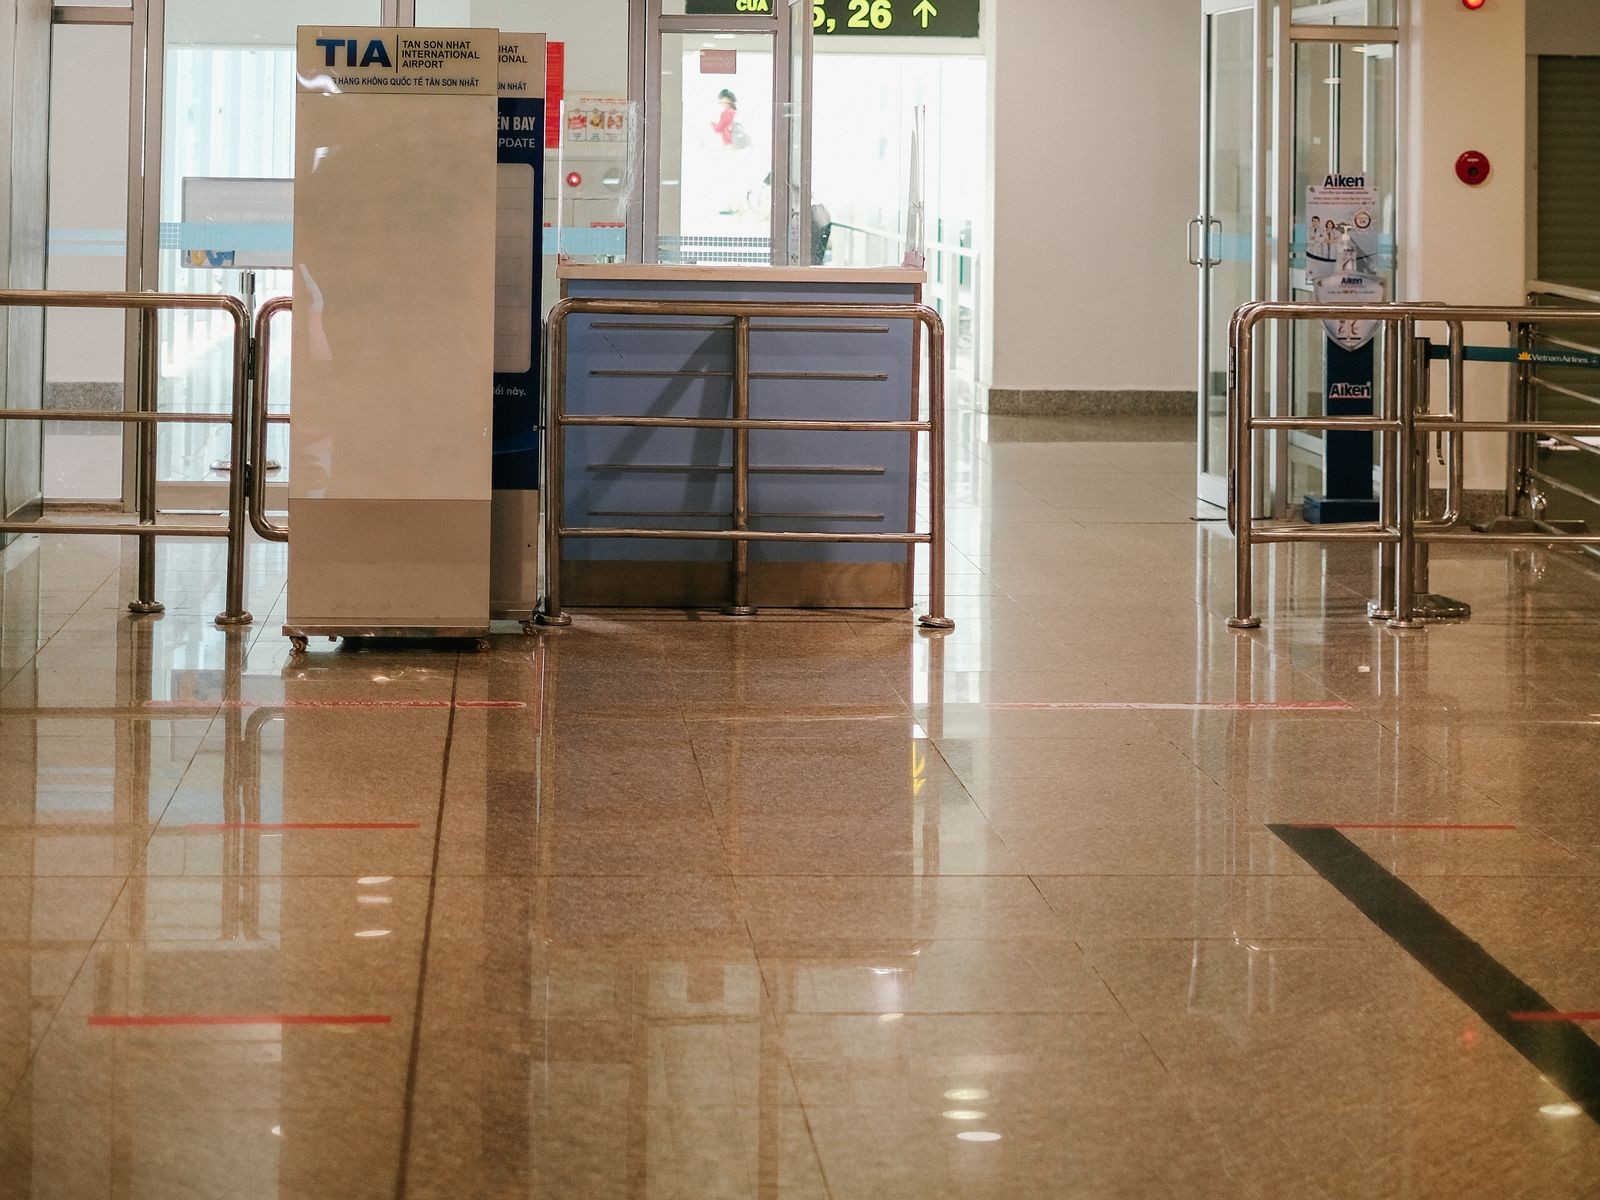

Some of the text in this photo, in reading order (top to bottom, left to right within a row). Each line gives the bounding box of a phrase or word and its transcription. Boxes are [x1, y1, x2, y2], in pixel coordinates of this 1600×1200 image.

[403, 41, 471, 50] TAN SON NHAT
[316, 39, 392, 67] TIA
[402, 50, 480, 59] INTERNATIONAL
[403, 60, 443, 68] AIRPORT
[362, 76, 388, 86] KHÔNG
[390, 76, 411, 87] QUỐC
[425, 77, 440, 86] TÂN
[513, 117, 535, 131] BAY
[498, 137, 535, 148] PDATE
[1324, 175, 1364, 187] Aiken
[1330, 382, 1370, 397] Aiken
